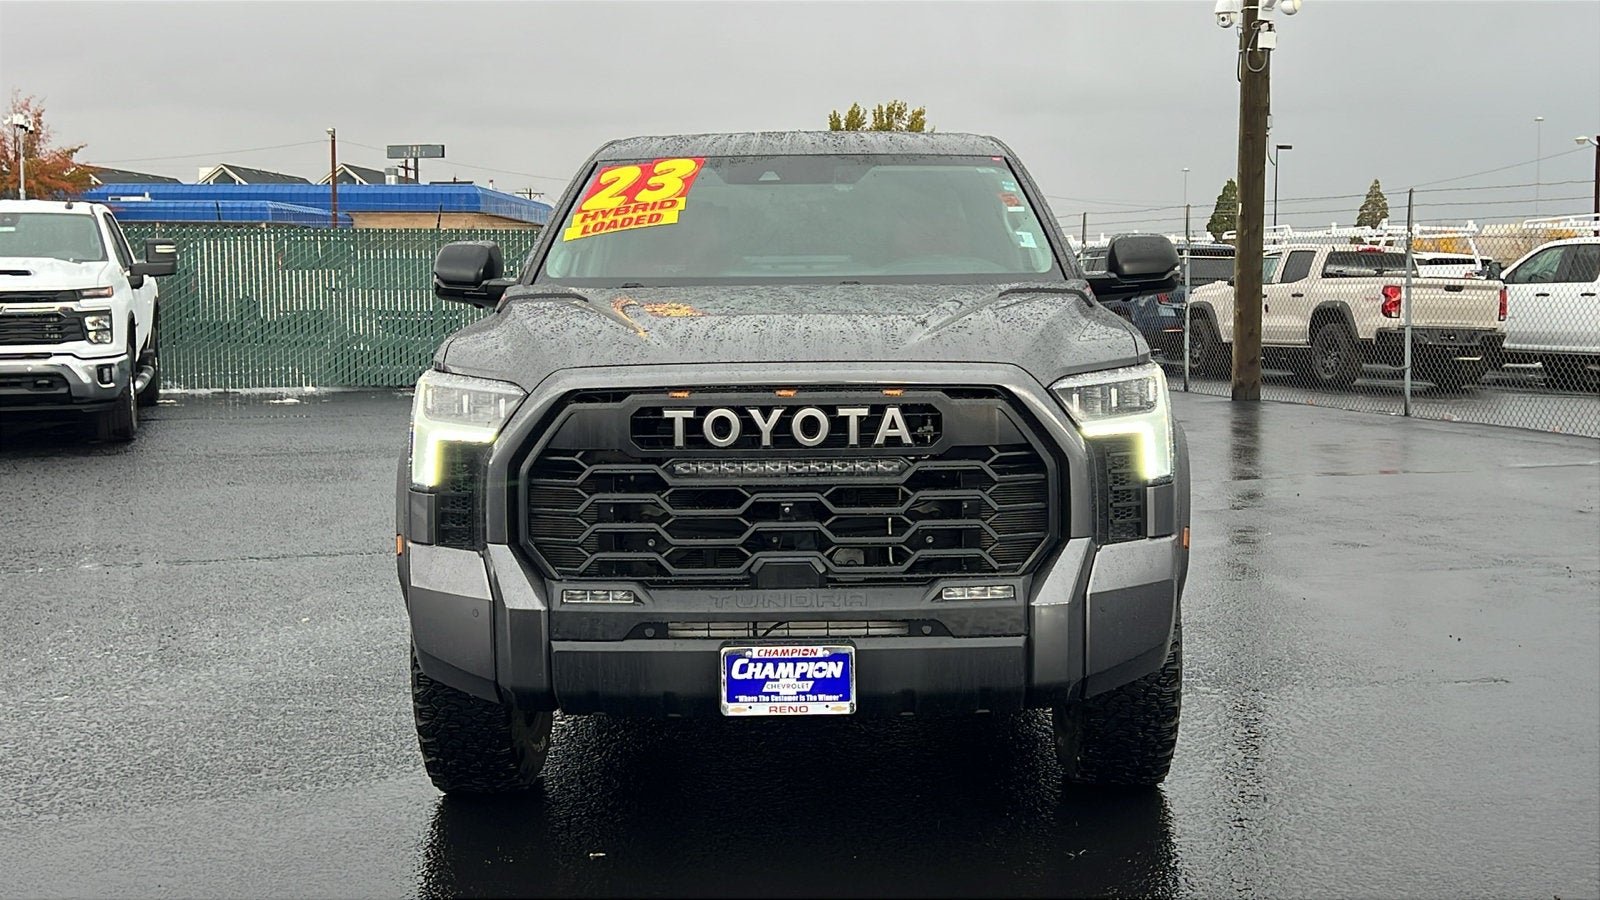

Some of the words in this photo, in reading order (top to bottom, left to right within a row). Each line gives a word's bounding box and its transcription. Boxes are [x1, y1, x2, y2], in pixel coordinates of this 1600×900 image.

[581, 158, 698, 211] 23
[580, 199, 679, 223] HYBRID
[580, 213, 664, 236] LOADED
[663, 407, 914, 448] TOYOTA
[708, 593, 868, 609] TUNDRA
[757, 648, 818, 657] CHAMPION
[768, 705, 809, 714] RENO
